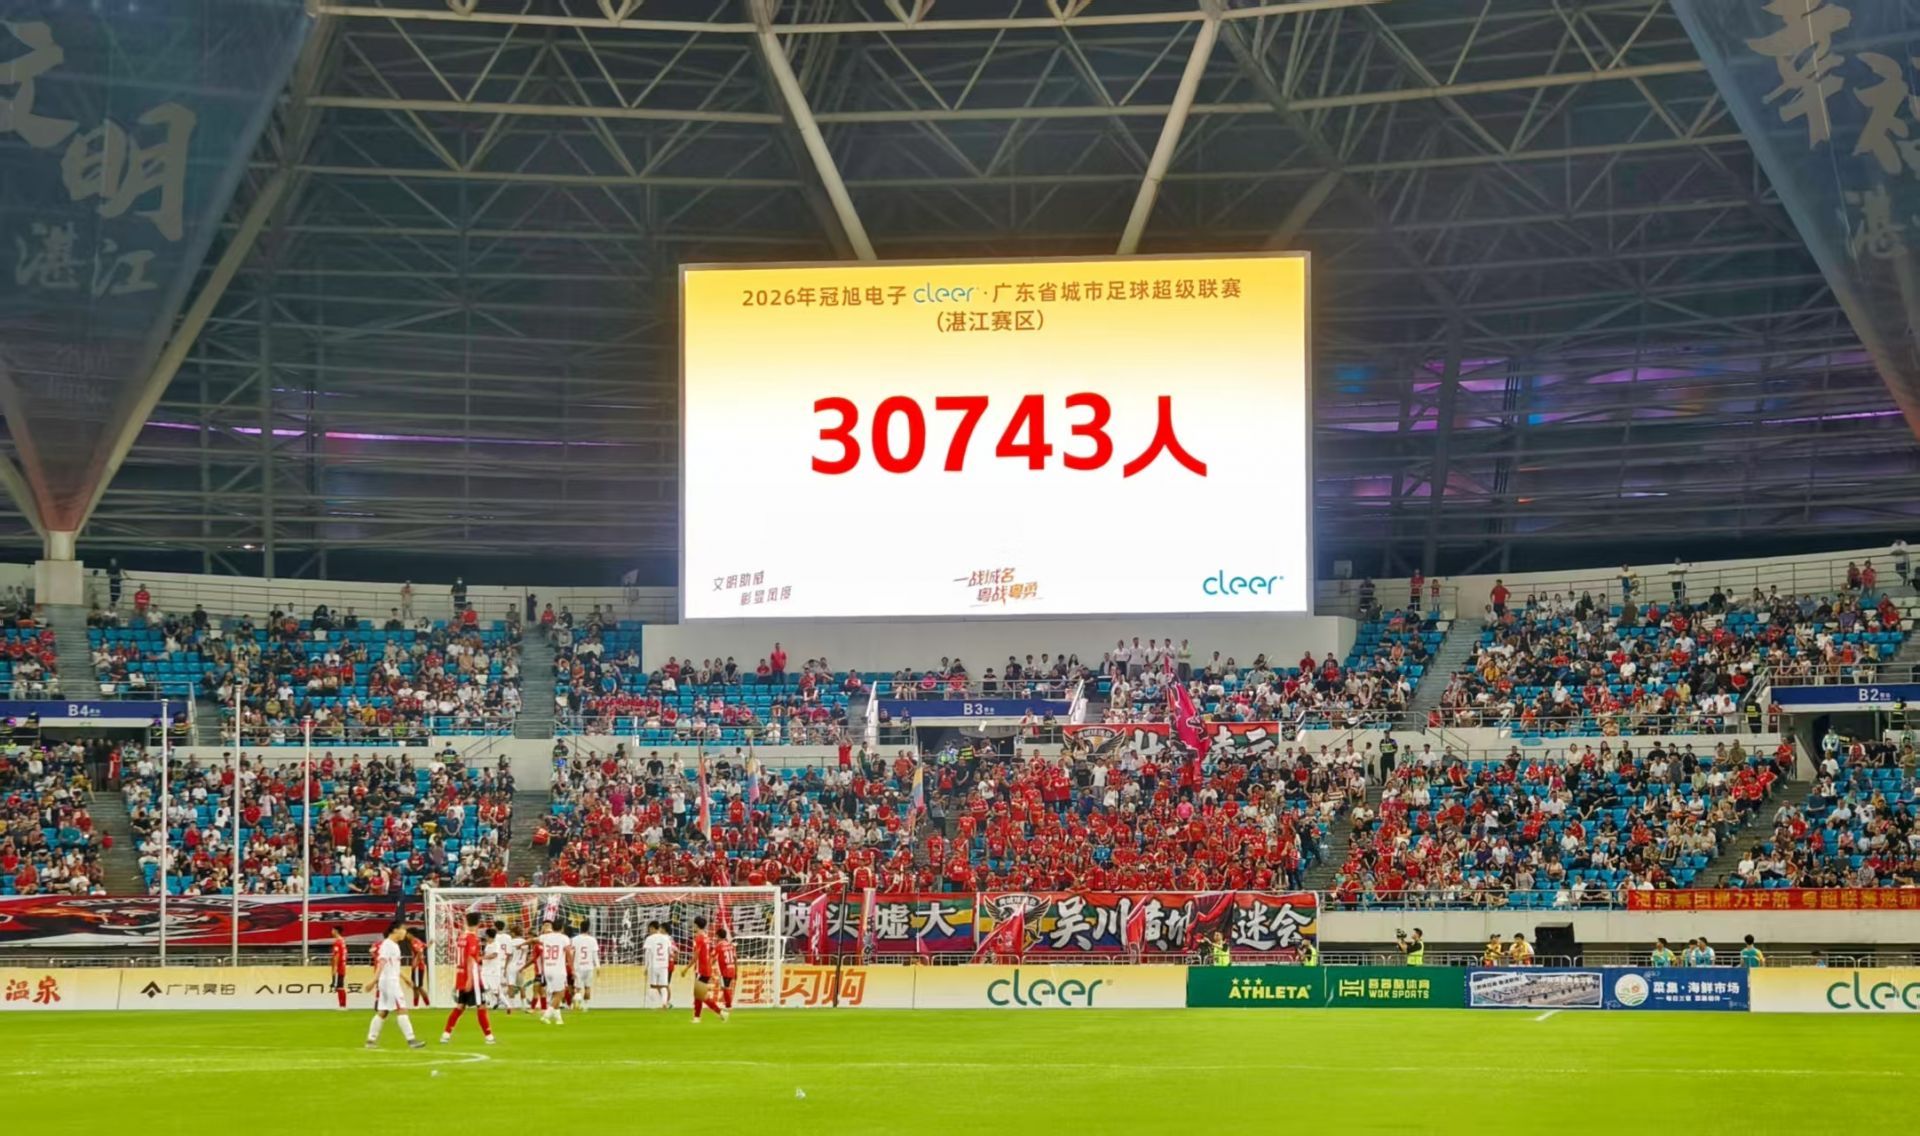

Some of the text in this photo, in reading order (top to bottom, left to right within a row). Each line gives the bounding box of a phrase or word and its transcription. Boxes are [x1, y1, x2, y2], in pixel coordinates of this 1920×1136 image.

[15, 221, 158, 295] 湛江
[742, 286, 907, 307] 2026年冠旭电子
[810, 391, 1208, 479] 30743人
[1202, 569, 1285, 597] cleer
[544, 944, 560, 960] 38
[580, 946, 588, 960] 5
[656, 943, 664, 957] 2
[5, 975, 61, 1005] 温泉
[166, 983, 236, 996] 广汽昊铂
[987, 969, 1104, 1007] cleer
[1229, 984, 1310, 1000] ATHLETA
[1392, 989, 1430, 999] SPORTS
